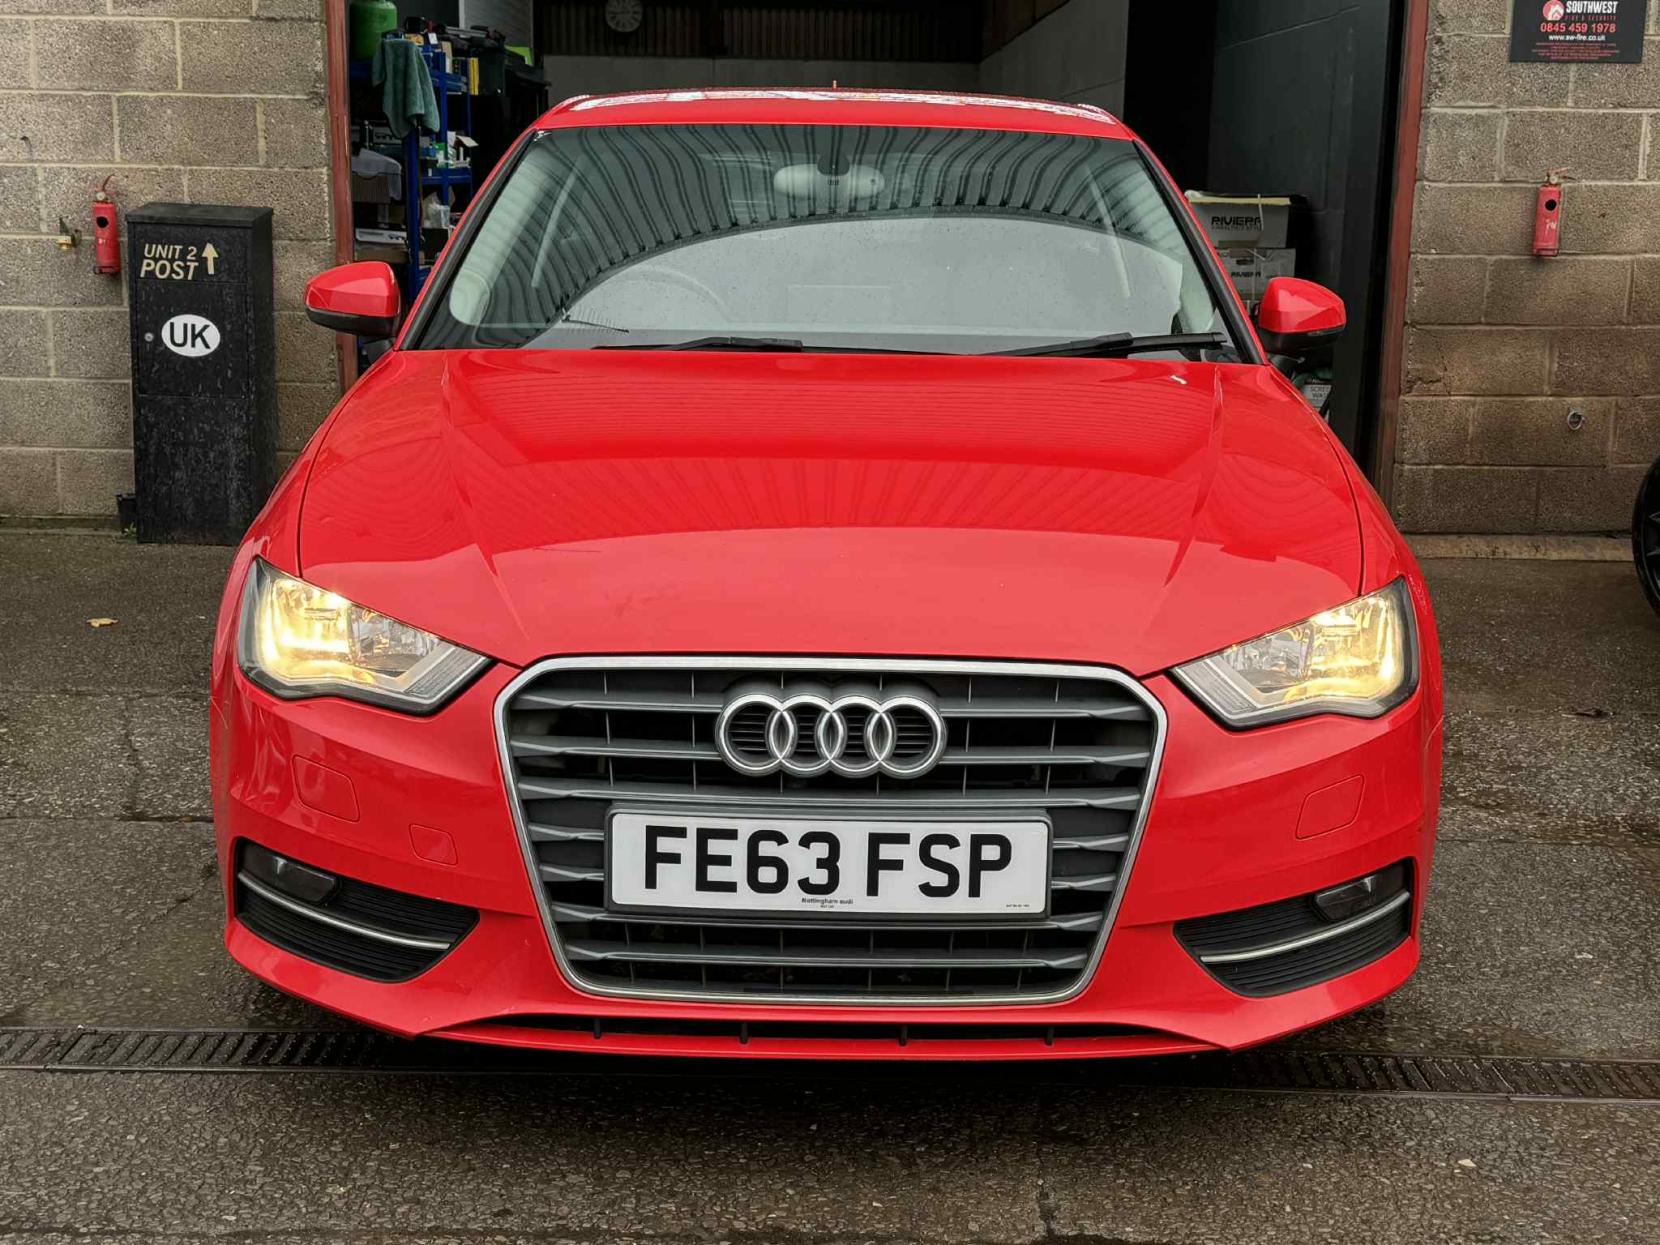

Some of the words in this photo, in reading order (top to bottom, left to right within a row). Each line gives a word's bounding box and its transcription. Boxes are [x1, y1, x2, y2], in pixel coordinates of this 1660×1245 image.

[1566, 1, 1618, 13] SOUTHWEST
[1540, 23, 1566, 33] 0845
[1568, 23, 1588, 33] 459
[1591, 23, 1616, 33] 1978
[144, 244, 183, 259] UNIT
[186, 246, 197, 260] 2
[140, 260, 199, 280] POST
[169, 321, 211, 350] UK
[645, 825, 841, 895] FE63
[867, 832, 1012, 897] FSP
